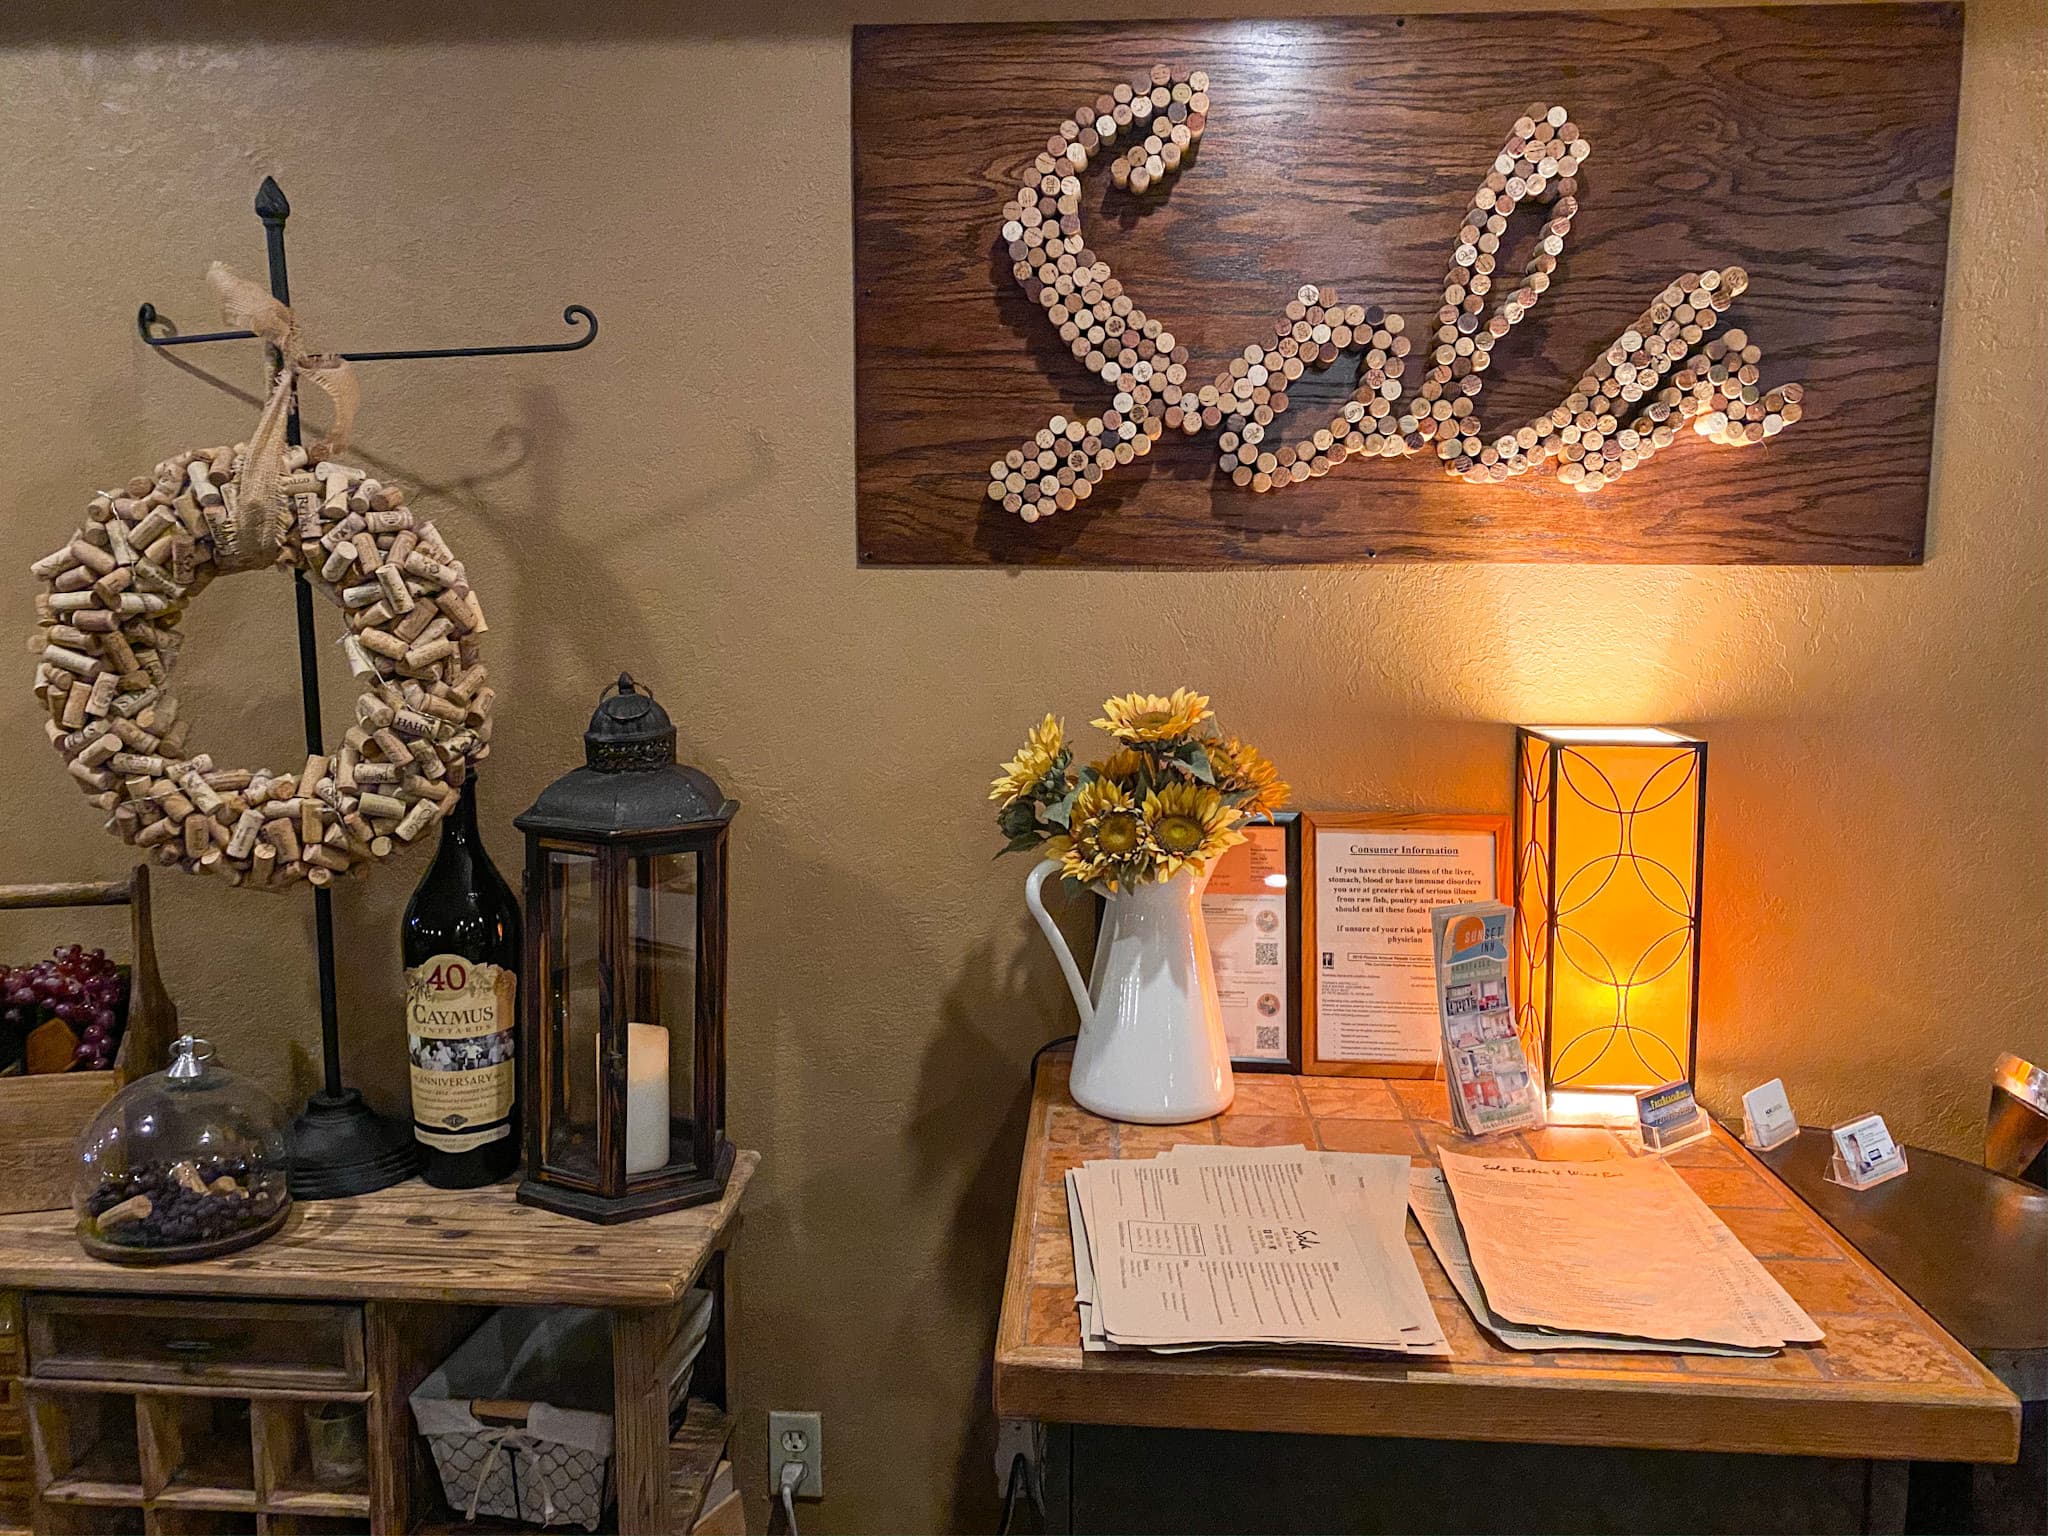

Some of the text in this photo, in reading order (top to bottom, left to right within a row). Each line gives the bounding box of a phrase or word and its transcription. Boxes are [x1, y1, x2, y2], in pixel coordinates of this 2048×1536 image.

[396, 717, 433, 737] HAHN
[1350, 845, 1459, 856] Consumer Information
[1343, 868, 1357, 876] you
[1359, 866, 1376, 874] have
[1377, 866, 1405, 875] chronic
[1407, 867, 1430, 875] illness
[1441, 867, 1453, 876] the
[1455, 867, 1474, 877] liver,
[1328, 875, 1361, 885] stomach,
[1363, 875, 1384, 884] blood
[1395, 876, 1413, 884] have
[1414, 876, 1445, 885] immune
[1446, 877, 1481, 885] disorders
[1333, 886, 1348, 894] you
[1372, 885, 1399, 895] greater
[1400, 885, 1414, 894] risk
[1426, 886, 1451, 894] serious
[1453, 886, 1477, 895] illness
[1336, 895, 1355, 903] from
[1373, 895, 1389, 905] fish,
[1390, 895, 1418, 905] poultry
[1419, 896, 1434, 904] and
[1435, 896, 1456, 905] meat.
[1335, 904, 1360, 913] should
[1361, 904, 1373, 913] eat
[1374, 905, 1384, 913] all
[1385, 905, 1405, 913] these
[1406, 905, 1426, 914] foods
[1381, 927, 1399, 935] your
[1400, 925, 1414, 934] risk
[1416, 925, 1432, 935] plea
[1465, 926, 1501, 944] SUNSET
[1388, 936, 1423, 944] physician
[1480, 942, 1495, 953] INN
[427, 963, 466, 991] 40
[413, 1004, 494, 1026] CAYMUS
[418, 1072, 493, 1088] ANNIVERSARY
[1482, 1164, 1509, 1173] Sola
[1292, 1230, 1321, 1250] Sola
